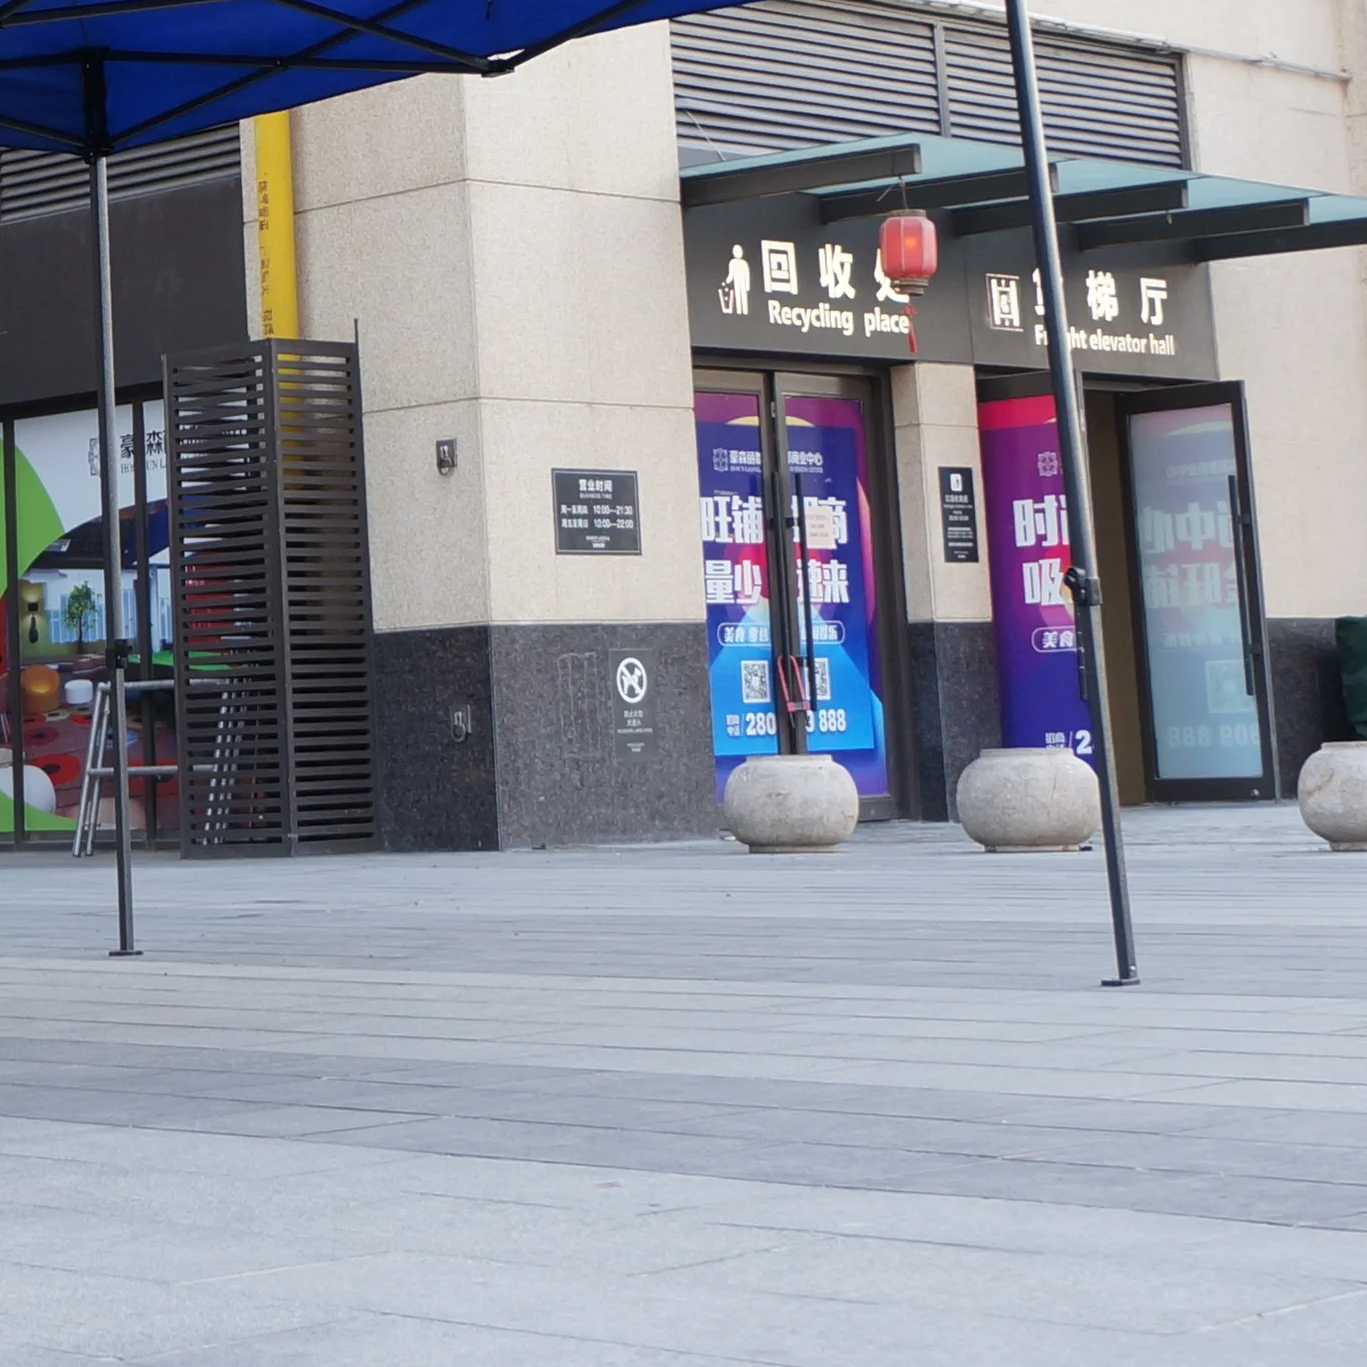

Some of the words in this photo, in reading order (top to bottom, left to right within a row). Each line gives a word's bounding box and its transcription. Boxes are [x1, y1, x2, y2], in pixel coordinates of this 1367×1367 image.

[768, 300, 854, 336] Recycling
[864, 307, 910, 337] place
[1089, 329, 1147, 356] elevator
[1150, 334, 1176, 356] hall
[1042, 630, 1074, 649] 美食
[818, 708, 847, 732] 888
